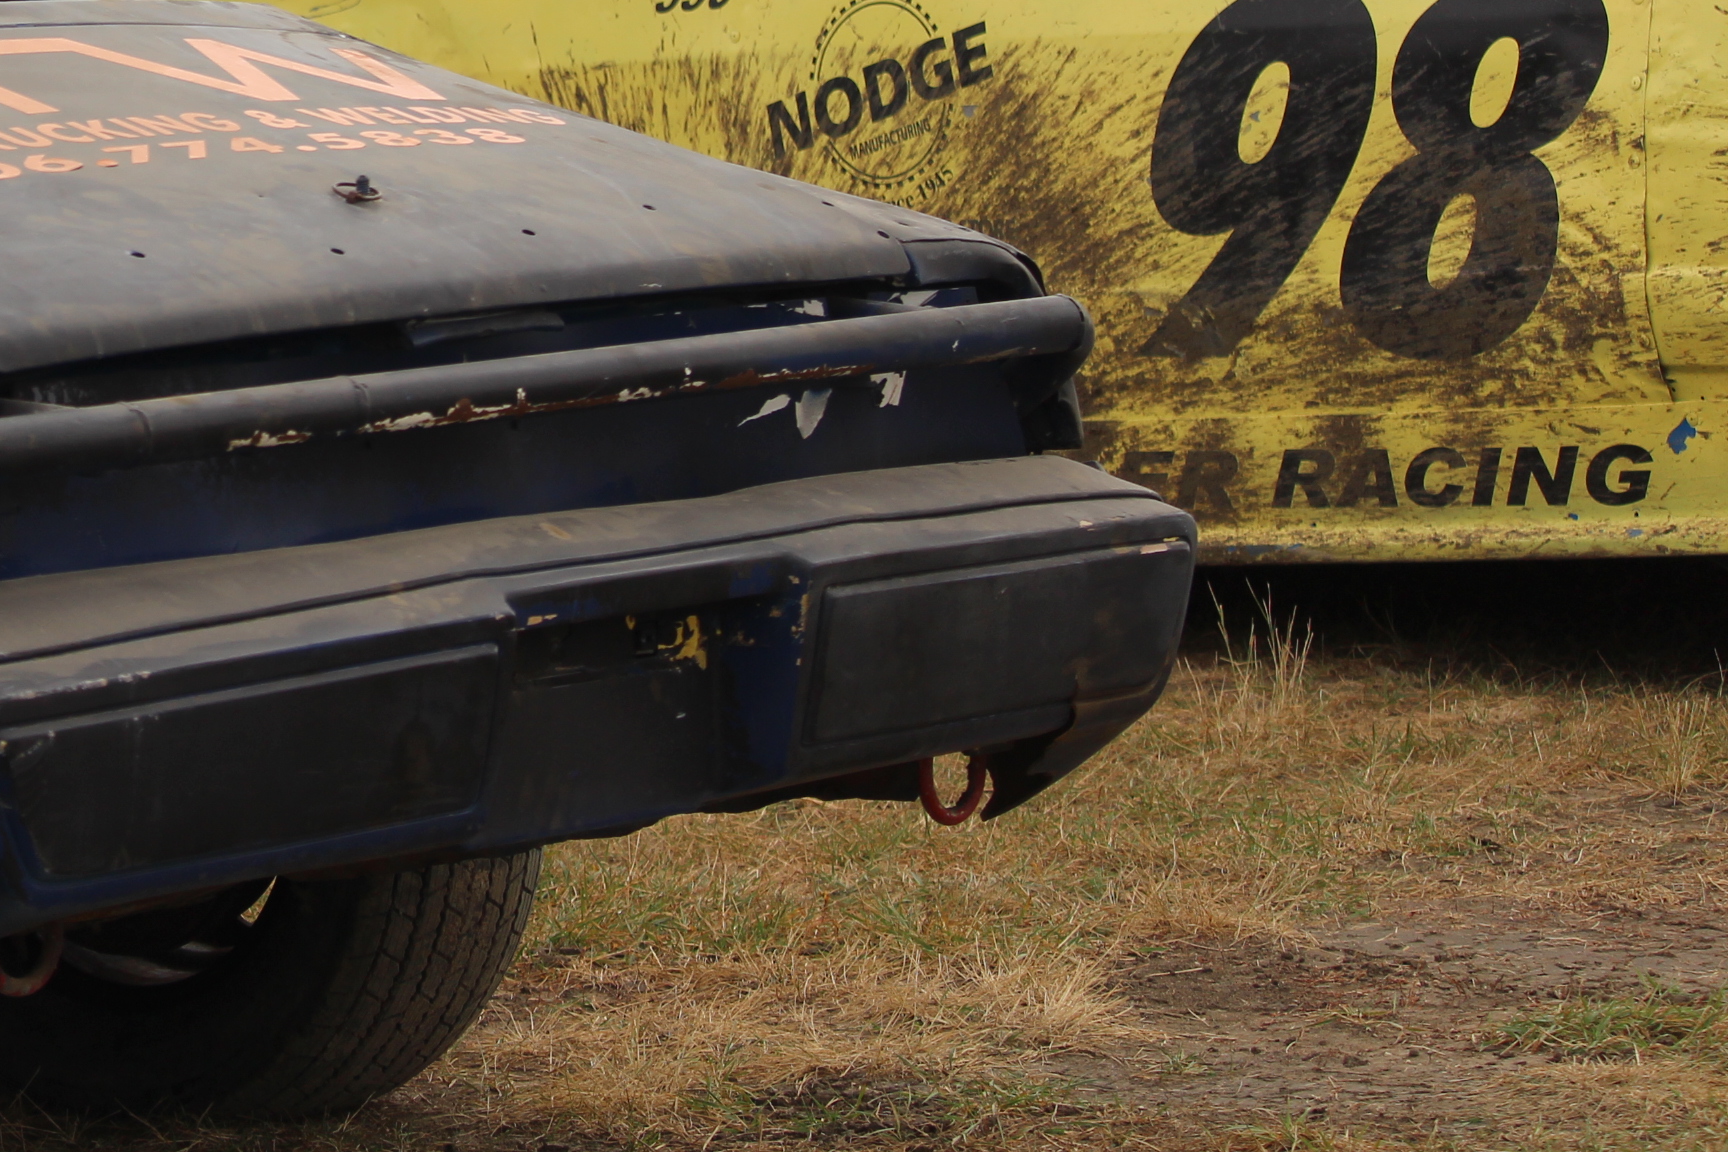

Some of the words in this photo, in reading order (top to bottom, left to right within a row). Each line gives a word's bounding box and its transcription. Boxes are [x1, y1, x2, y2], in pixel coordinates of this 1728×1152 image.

[766, 21, 994, 159] NODGE
[243, 109, 312, 129] &
[294, 105, 566, 126] WELDING
[849, 118, 932, 161] MANUFACTURING
[916, 163, 954, 203] 1945
[1271, 443, 1655, 509] RACING
